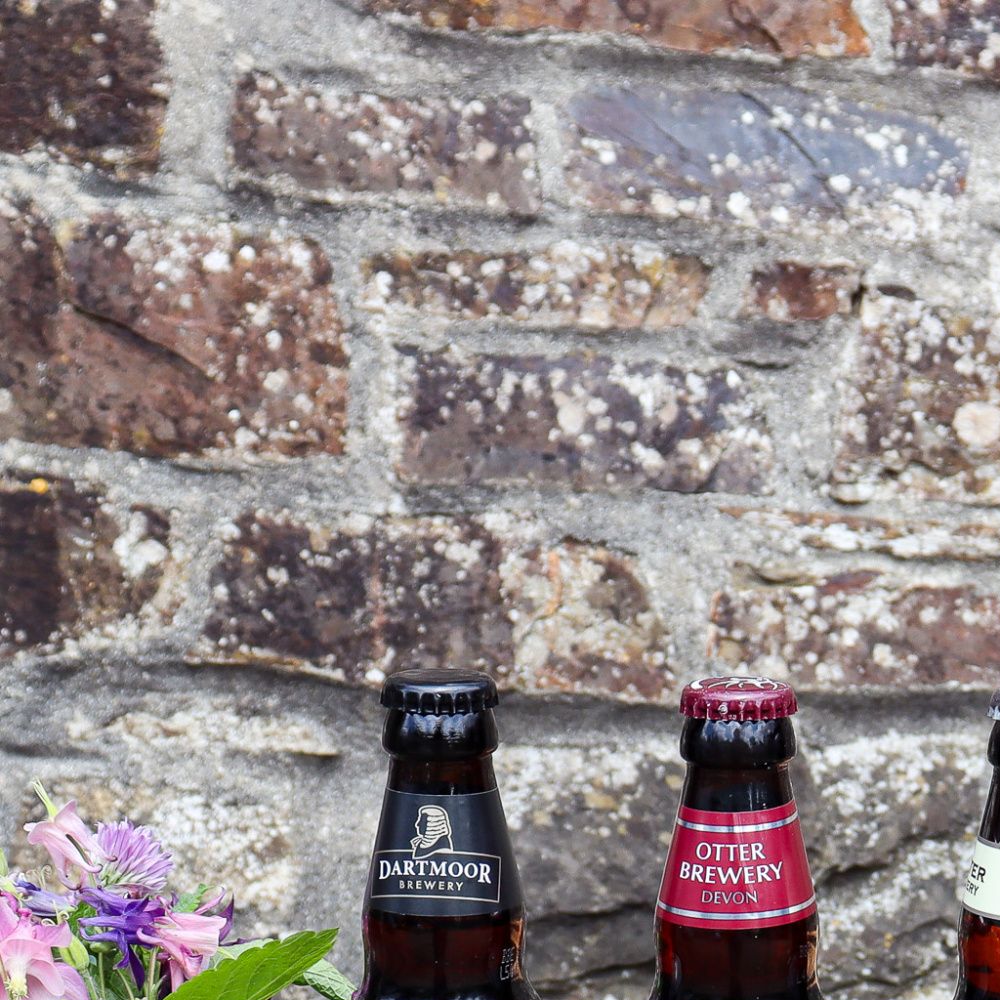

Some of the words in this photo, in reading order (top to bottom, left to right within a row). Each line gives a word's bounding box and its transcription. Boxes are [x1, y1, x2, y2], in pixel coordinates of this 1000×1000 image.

[696, 842, 766, 861] OTTER
[379, 859, 491, 884] DARTMOOR
[680, 862, 783, 884] BREWERY
[399, 880, 464, 891] BREWERY
[701, 890, 758, 905] DEVON
